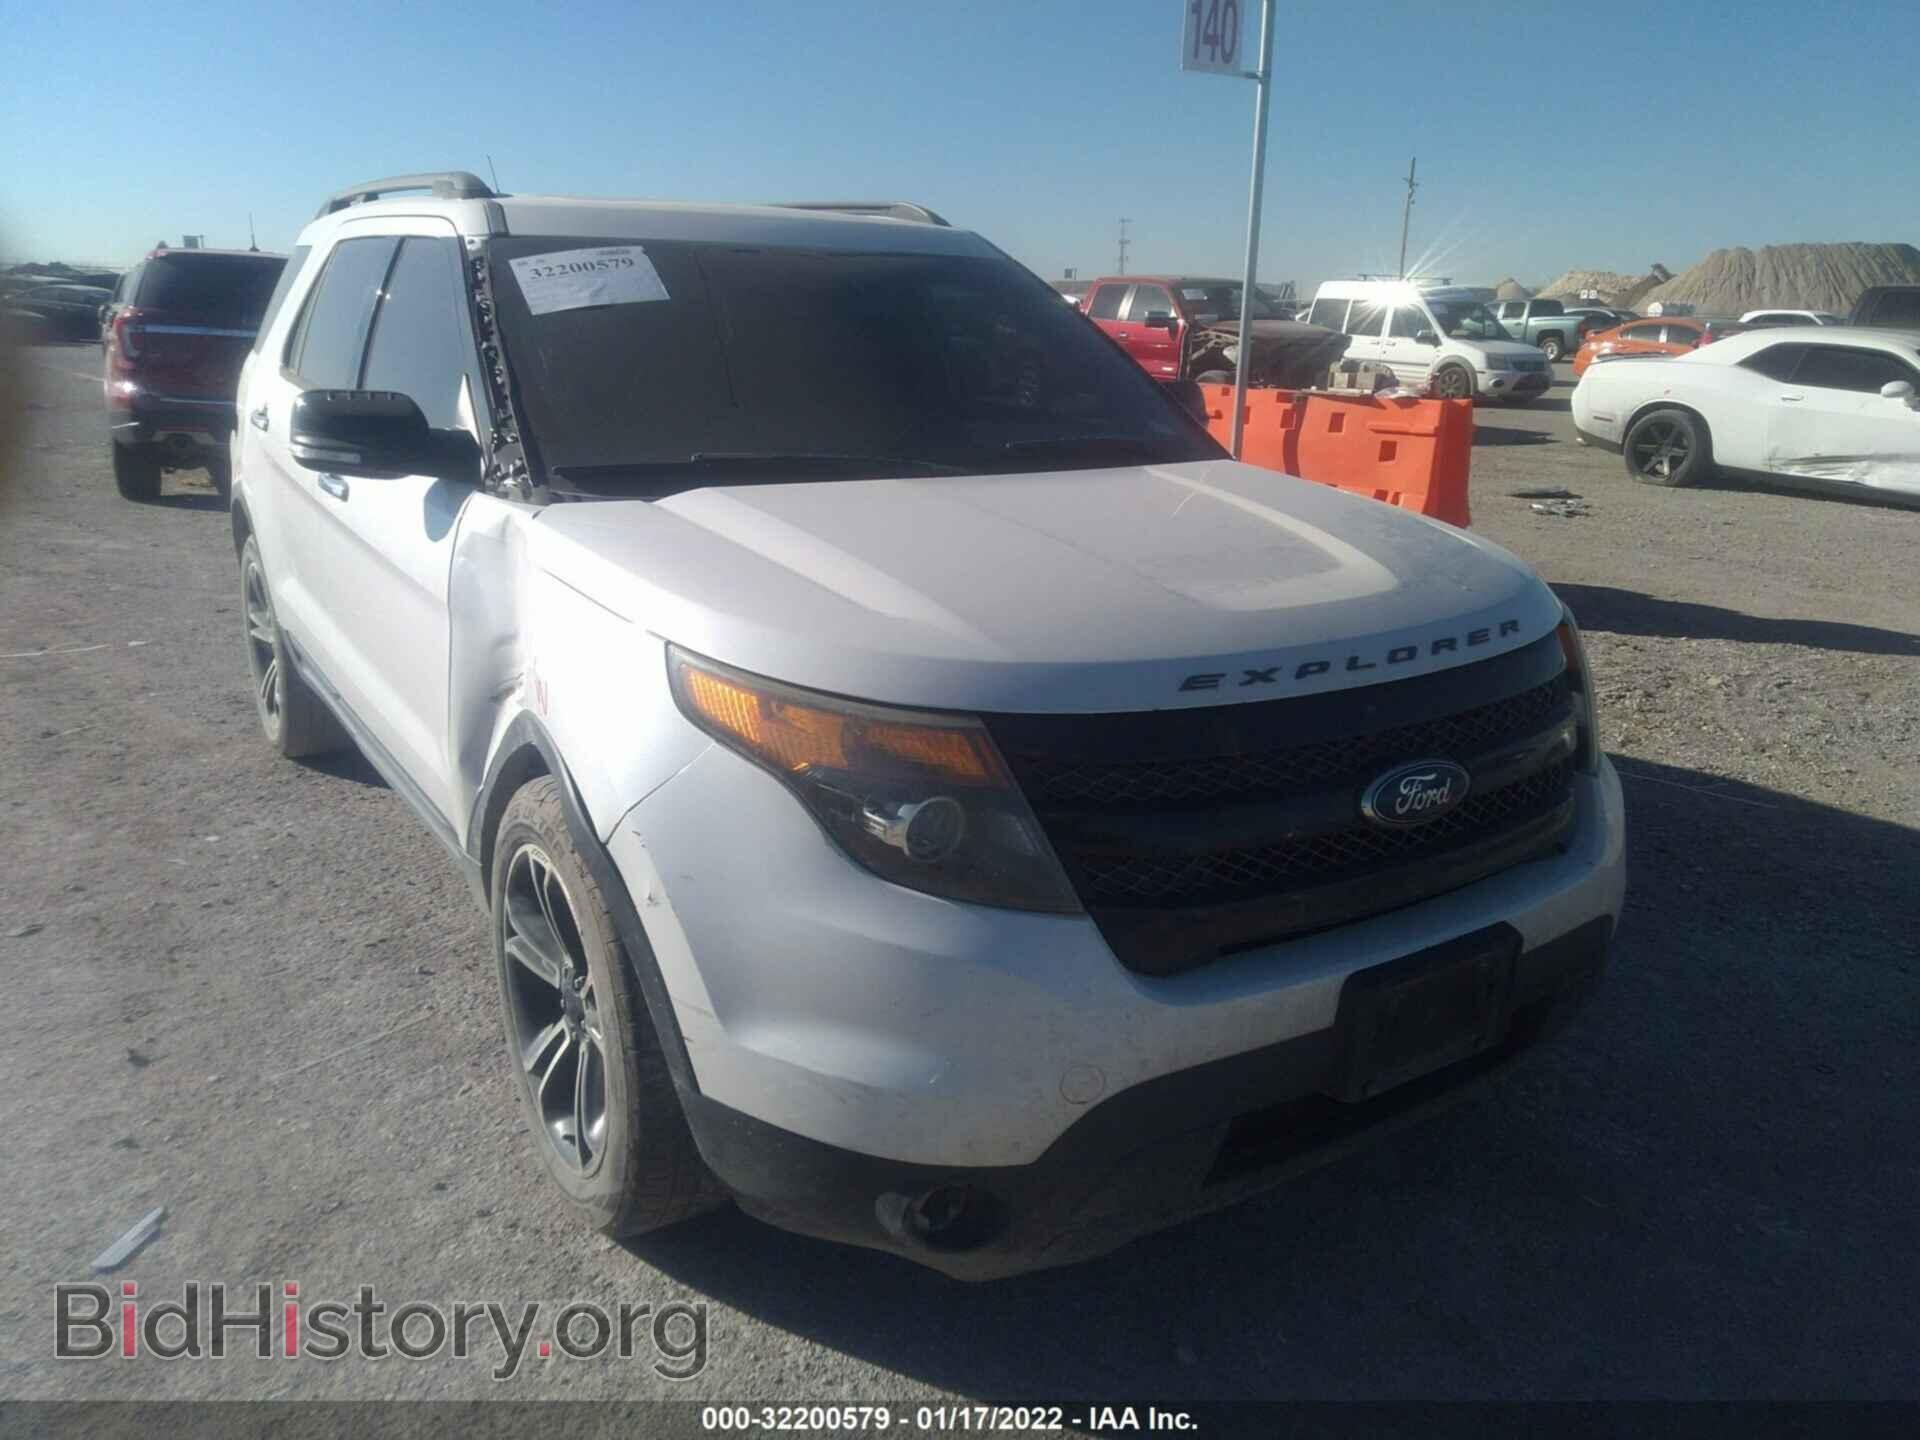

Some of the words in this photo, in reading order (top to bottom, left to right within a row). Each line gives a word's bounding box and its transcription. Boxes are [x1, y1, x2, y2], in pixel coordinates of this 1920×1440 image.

[1192, 0, 1239, 64] 140
[529, 257, 634, 280] 32200579
[1178, 619, 1520, 692] EXPLORER
[1395, 773, 1450, 815] Ford
